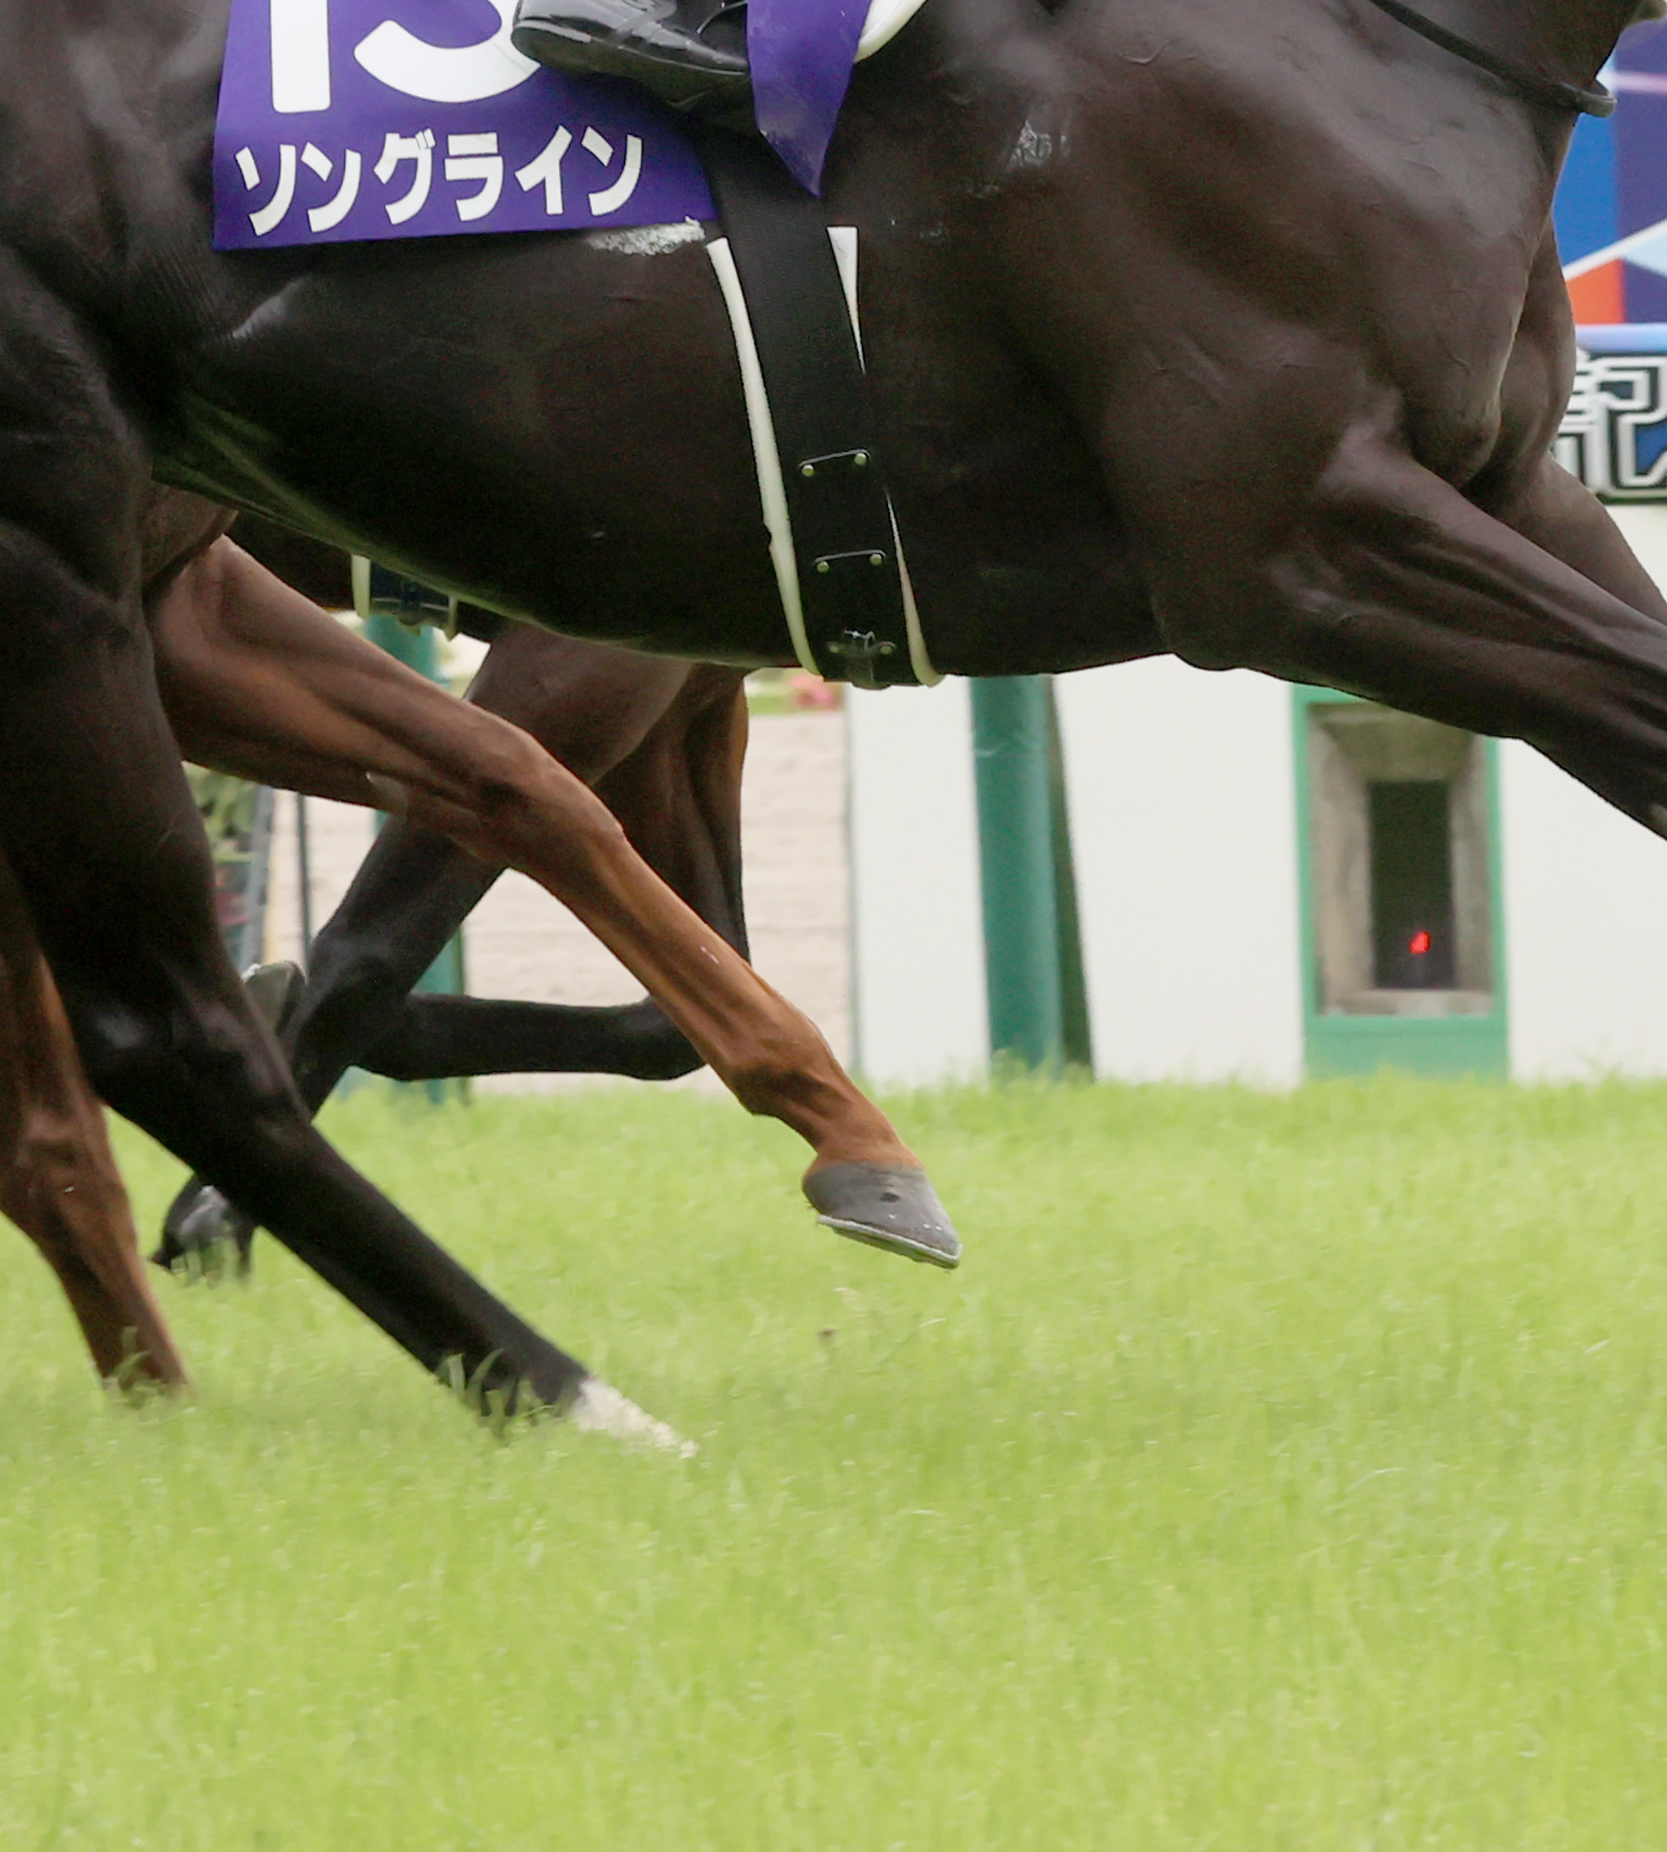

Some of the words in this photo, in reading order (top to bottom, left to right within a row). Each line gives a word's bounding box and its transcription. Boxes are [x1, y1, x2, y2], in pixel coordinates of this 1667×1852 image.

[235, 126, 643, 237] ソングライン
